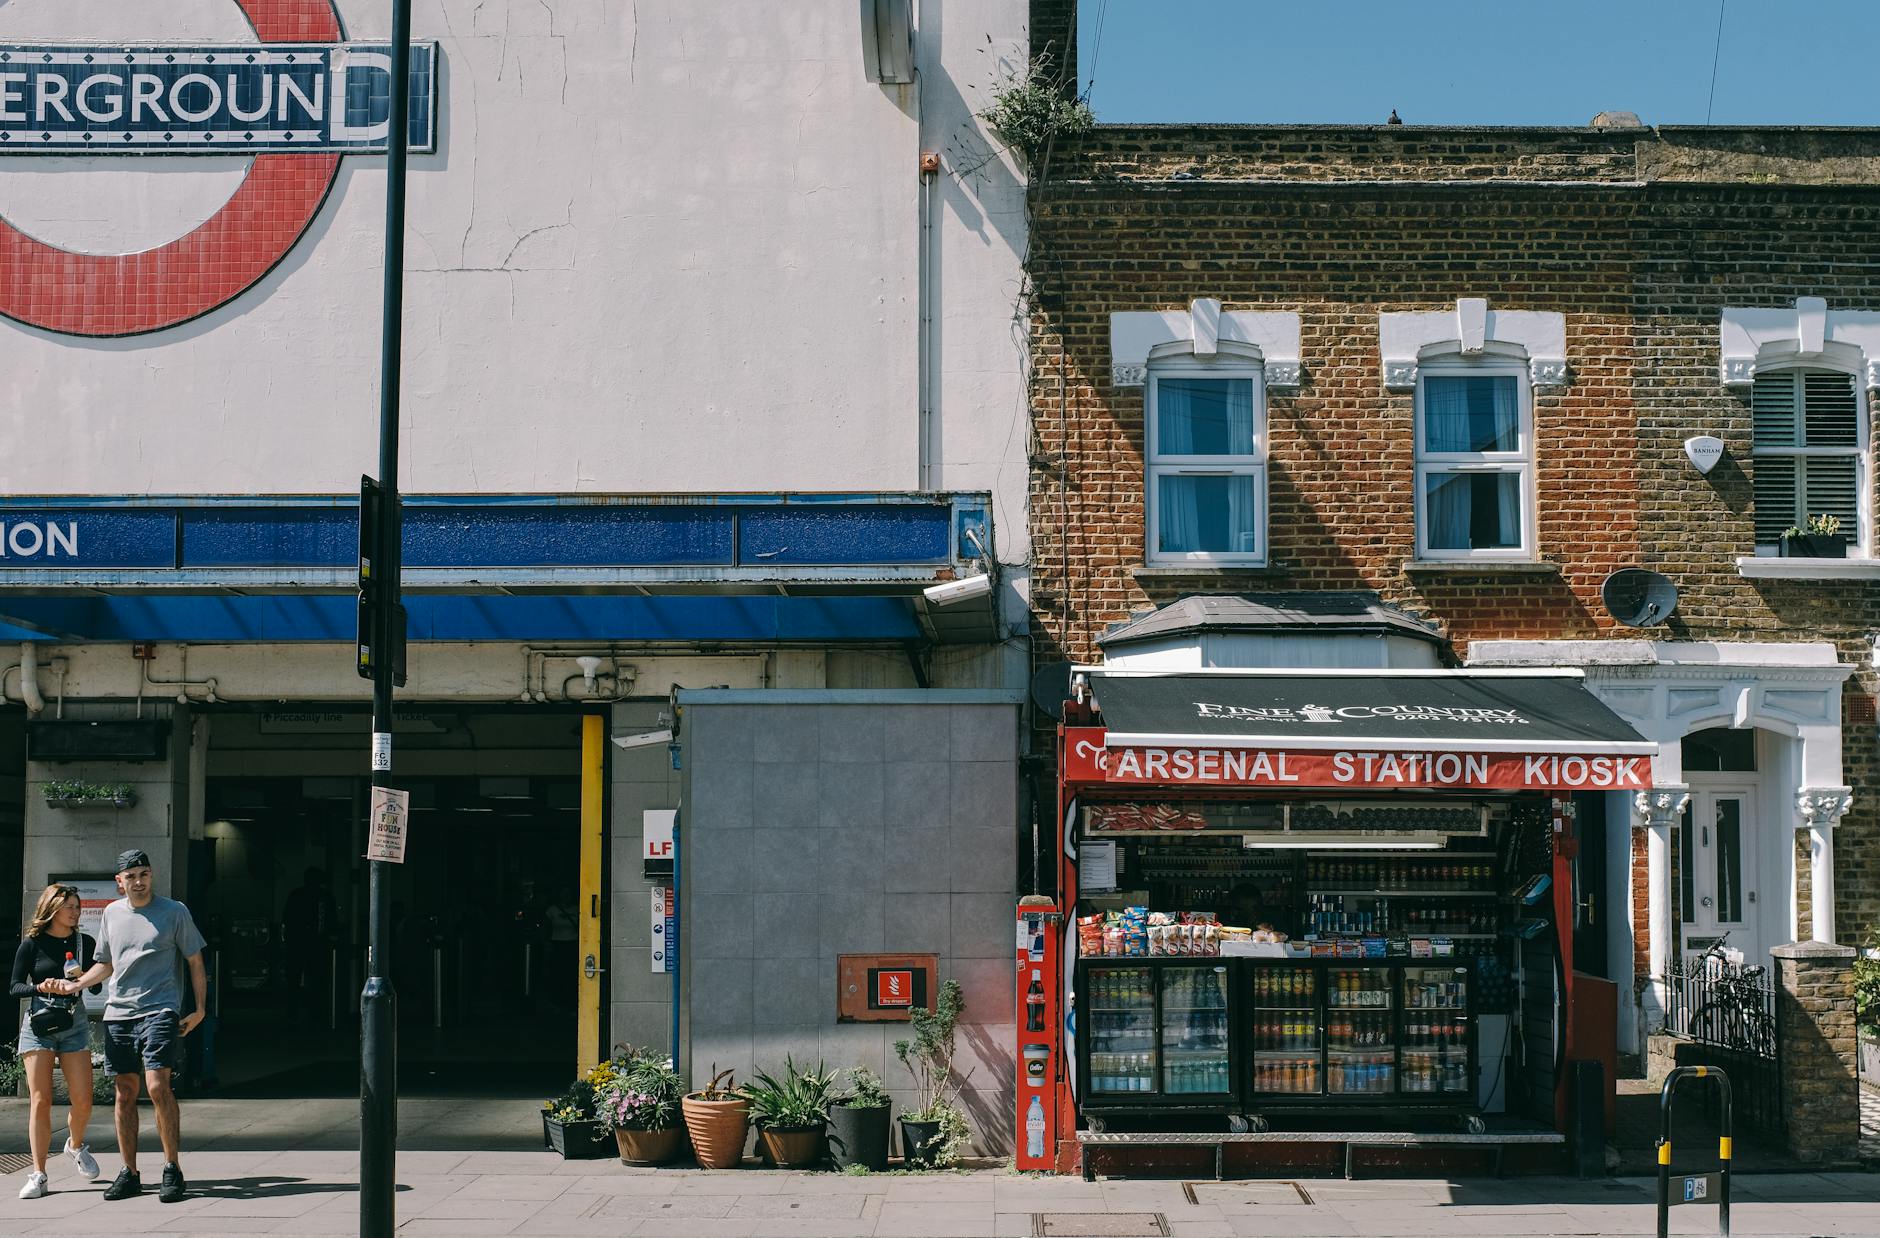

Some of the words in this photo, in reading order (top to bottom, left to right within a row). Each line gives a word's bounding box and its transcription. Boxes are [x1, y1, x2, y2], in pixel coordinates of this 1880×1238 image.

[0, 52, 392, 142] ERGROUND
[274, 711, 320, 723] Piccadilly
[324, 711, 343, 721] line
[1193, 702, 1295, 717] FINE
[1336, 704, 1517, 719] COUNTRY
[1116, 748, 1298, 781] ARSENAL
[1332, 751, 1488, 784] STATION
[1524, 756, 1643, 787] KIOSK
[377, 823, 401, 835] HOUSE
[82, 908, 104, 916] rsenal
[1687, 1181, 1693, 1198] P
